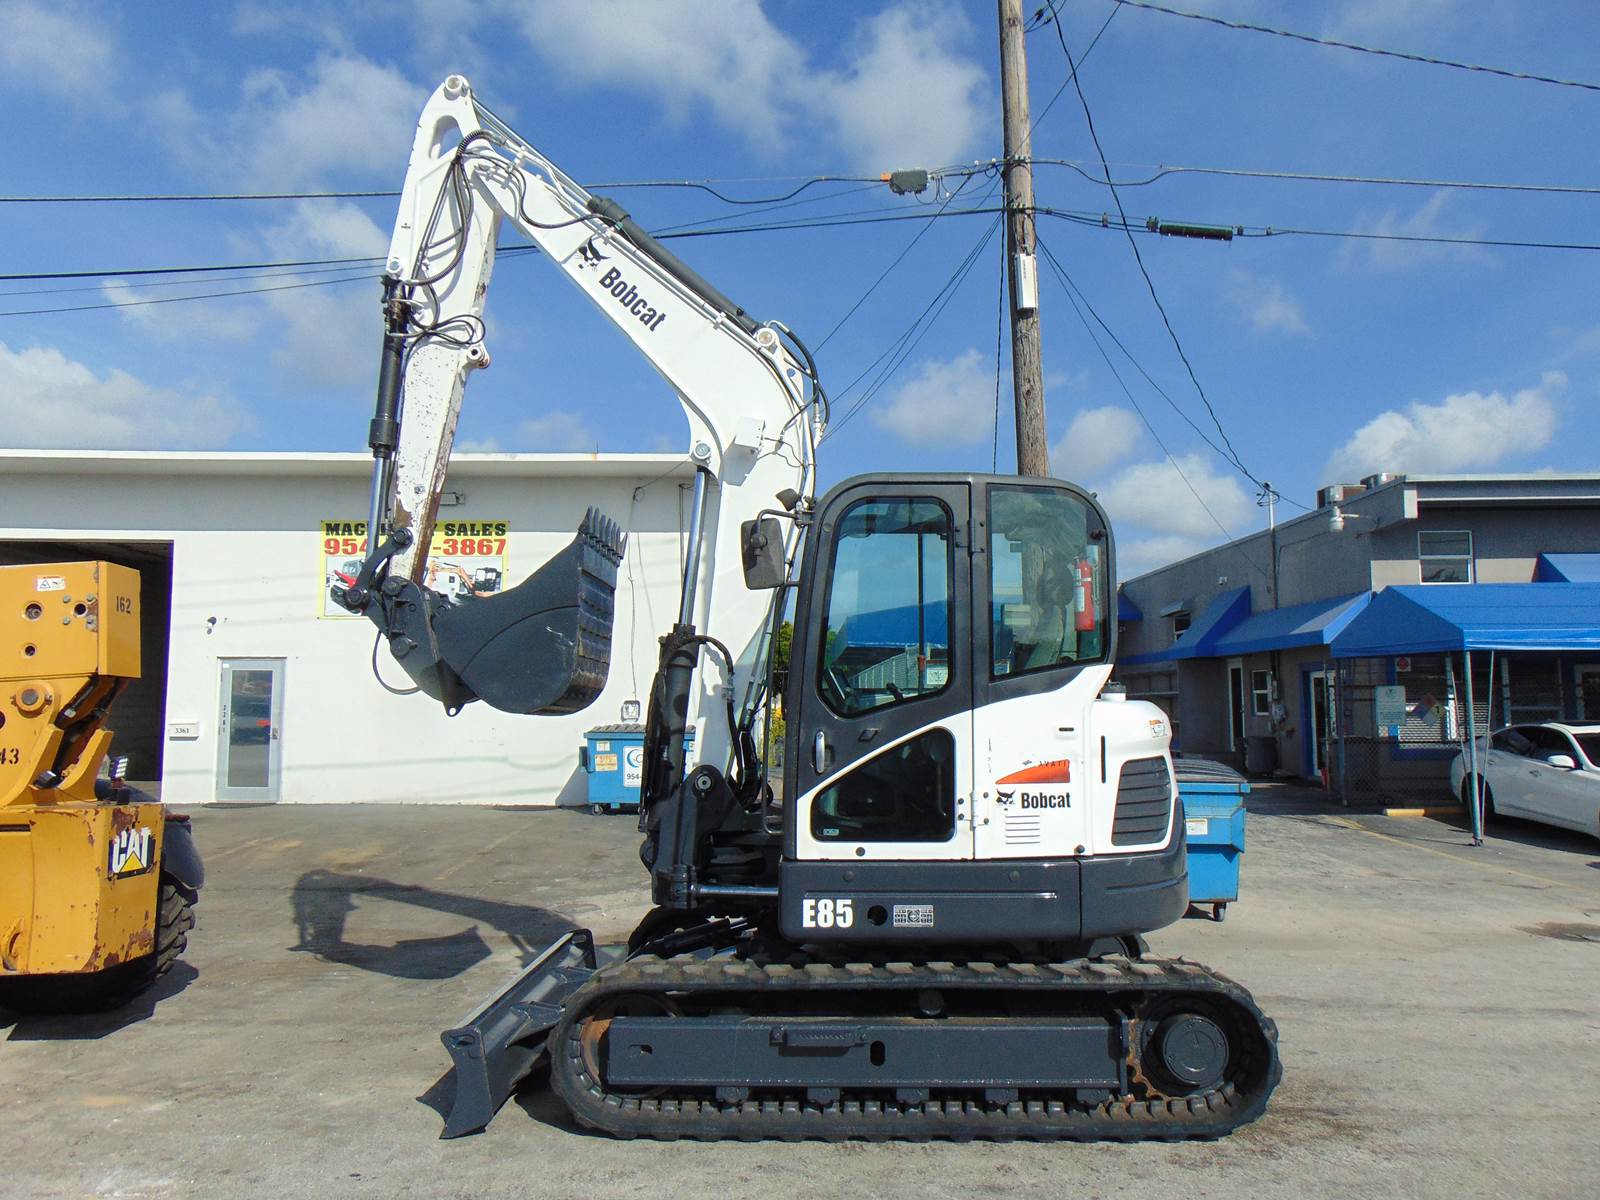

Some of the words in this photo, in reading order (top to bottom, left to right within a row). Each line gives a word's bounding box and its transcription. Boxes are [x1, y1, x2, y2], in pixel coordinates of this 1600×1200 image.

[599, 266, 667, 332] Bobcat
[444, 523, 506, 537] SALES
[116, 596, 131, 614] 162
[1021, 792, 1071, 809] Bobcat
[112, 827, 152, 874] CAT
[802, 898, 854, 928] E85
